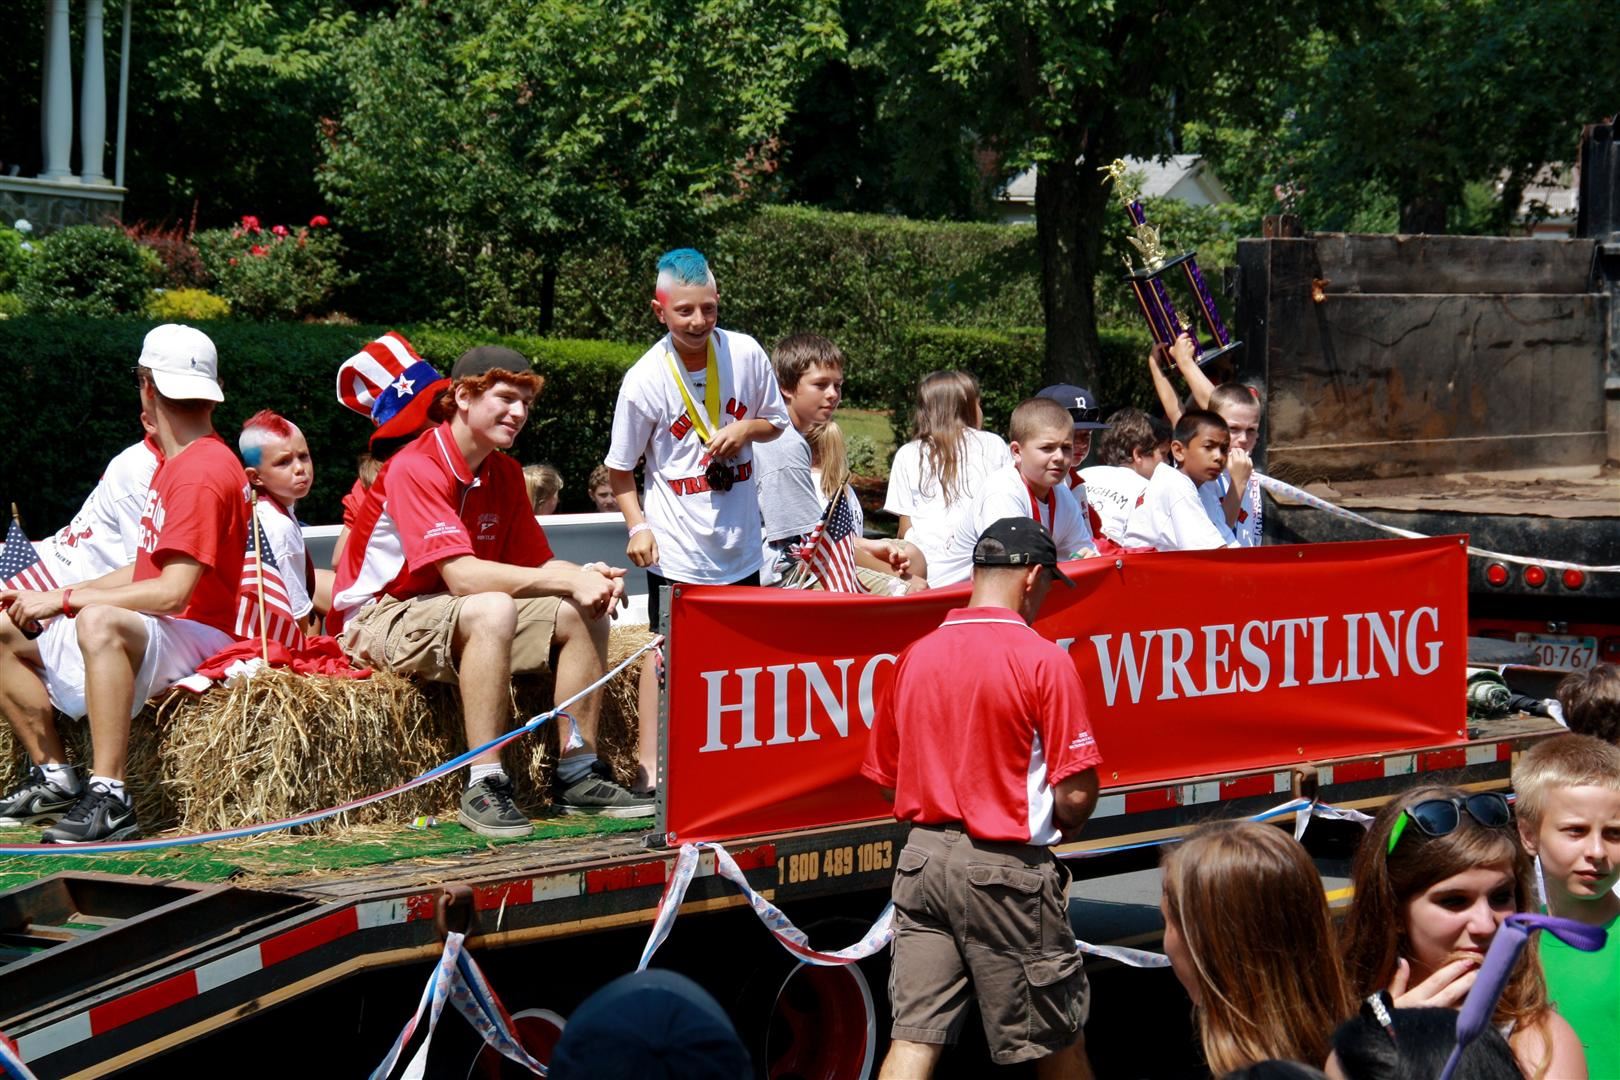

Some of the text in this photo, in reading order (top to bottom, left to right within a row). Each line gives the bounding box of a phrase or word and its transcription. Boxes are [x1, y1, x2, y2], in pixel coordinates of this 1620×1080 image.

[1090, 606, 1443, 707] WRESTLING
[778, 840, 892, 885] 1 800 489 1063
